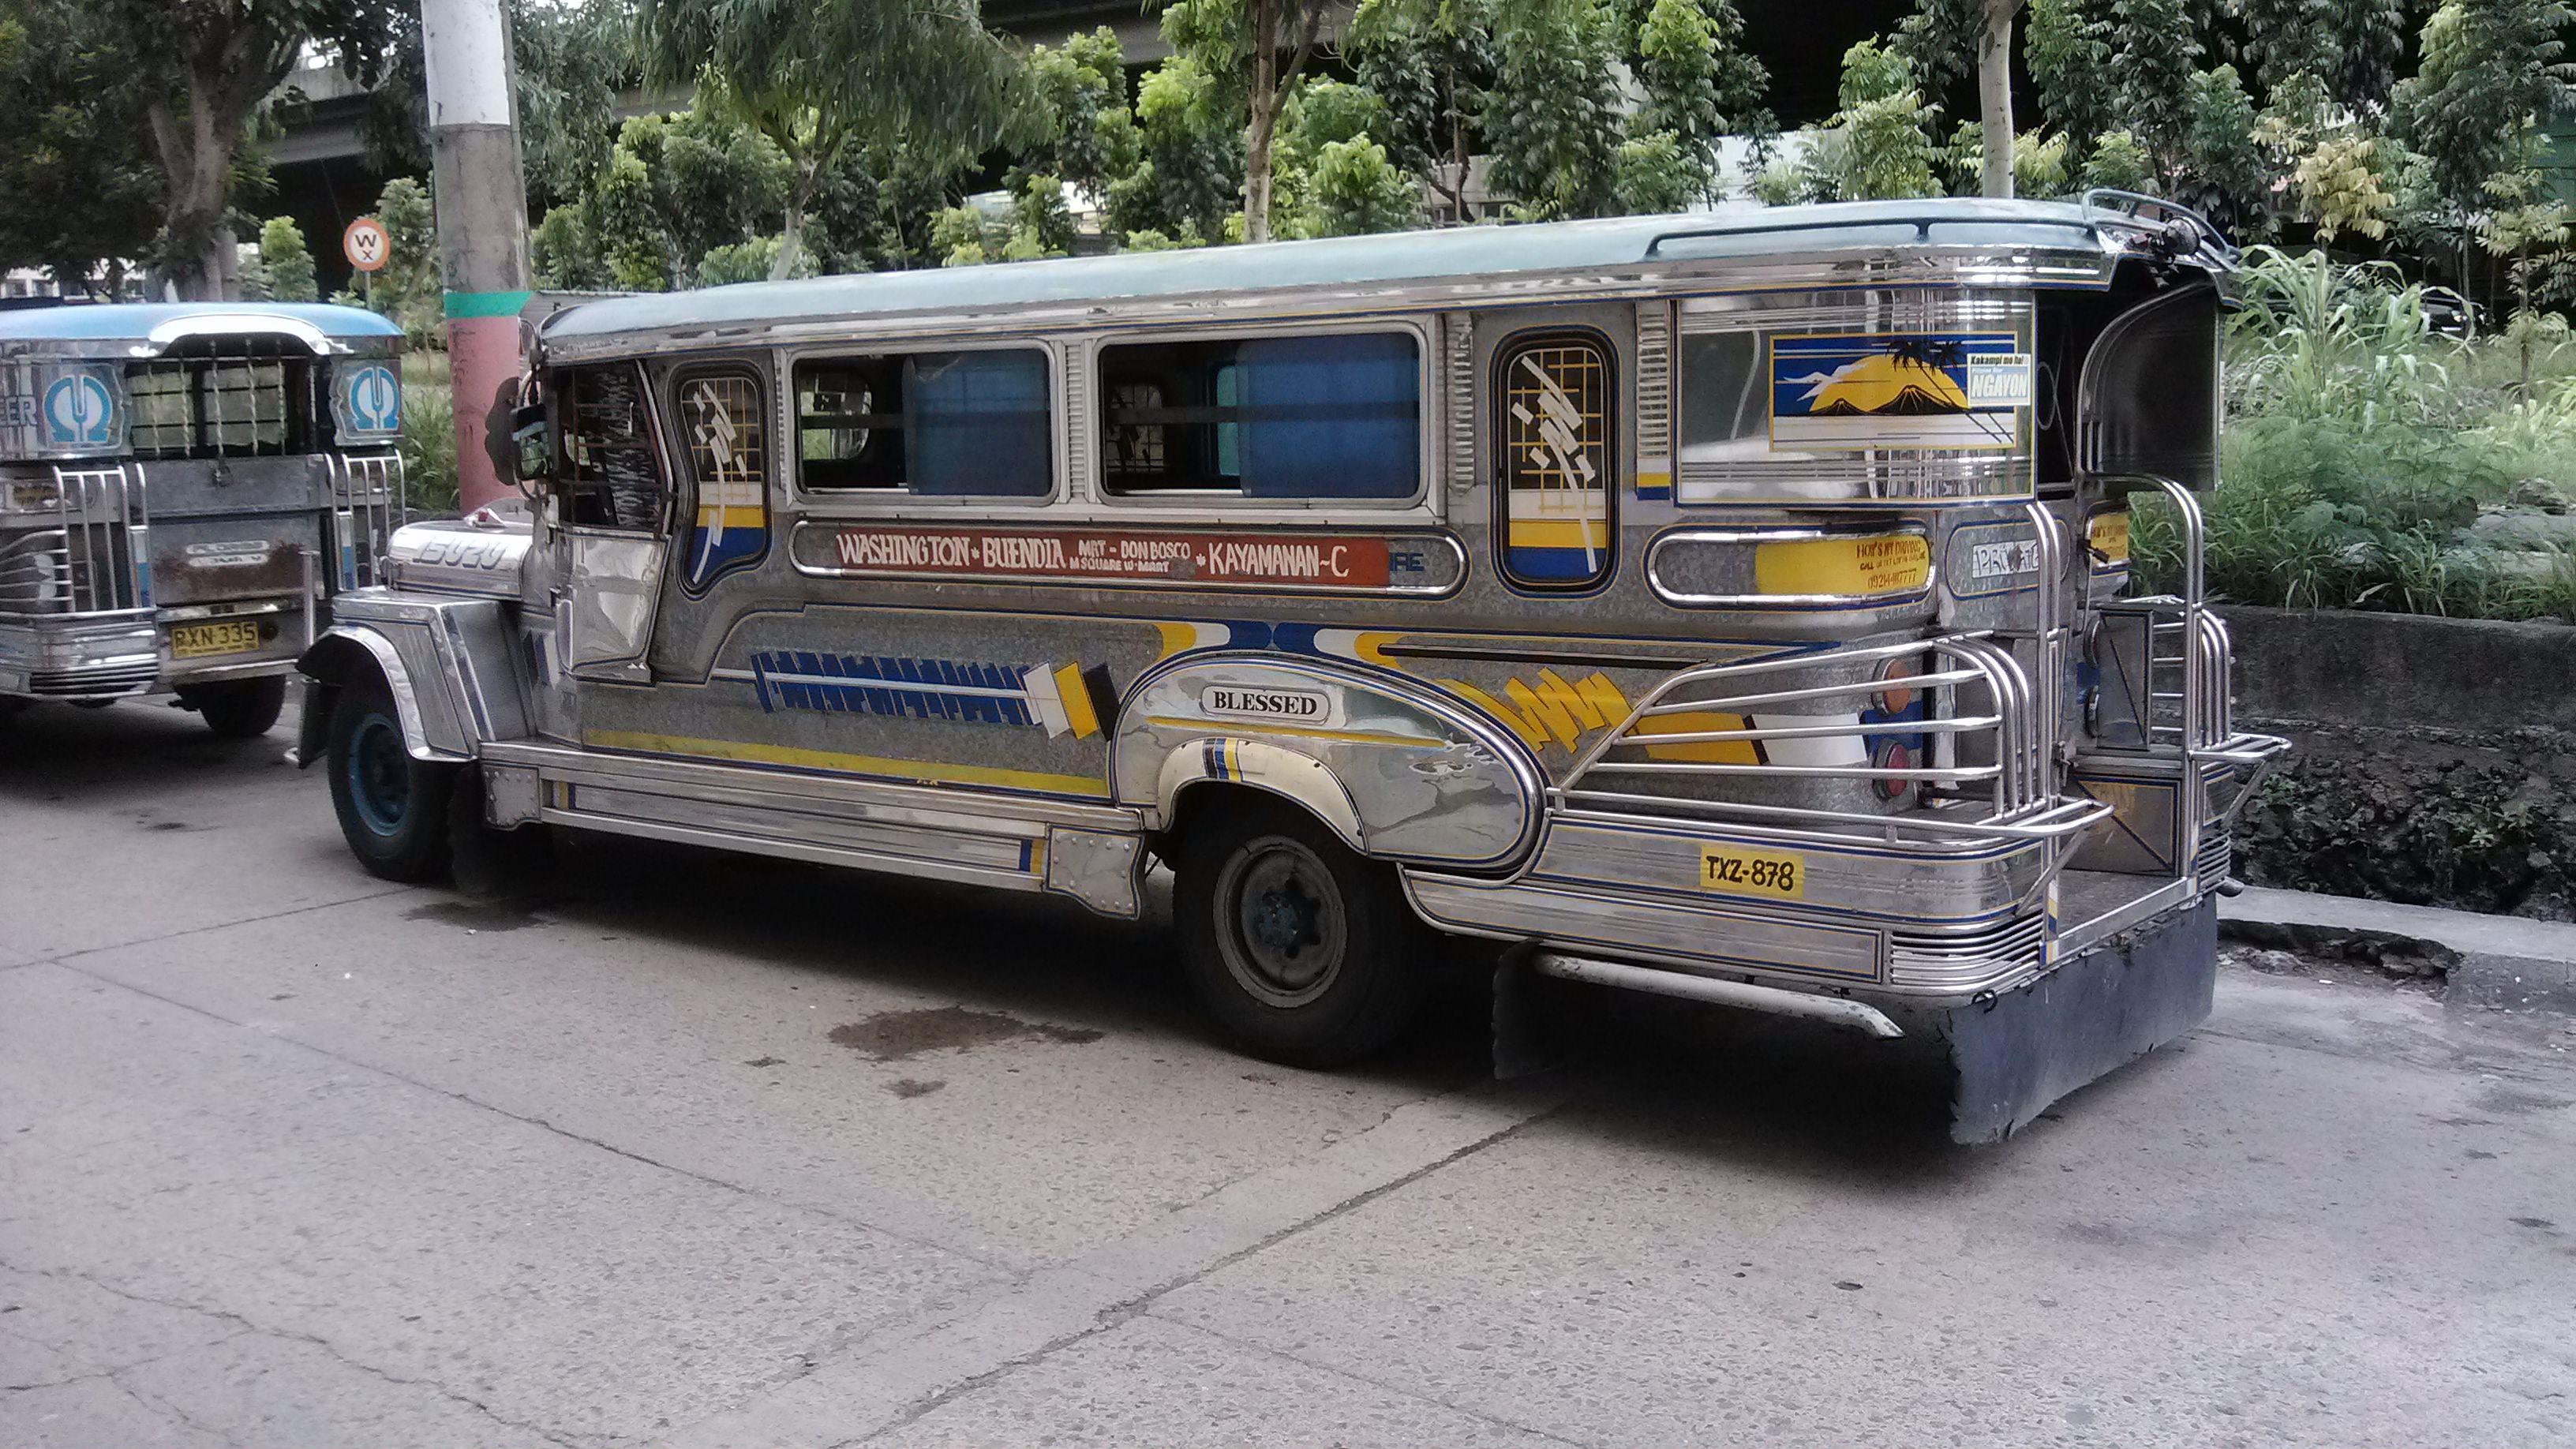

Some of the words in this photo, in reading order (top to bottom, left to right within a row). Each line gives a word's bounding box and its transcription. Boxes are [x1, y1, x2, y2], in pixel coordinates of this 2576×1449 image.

[355, 234, 376, 247] W
[1971, 374, 2027, 397] NGAYON
[412, 537, 508, 570] ISUZU
[837, 534, 970, 567] WASHINGTON
[983, 537, 1066, 569] BUENDIA
[1078, 540, 1106, 558] MRT
[1149, 541, 1191, 560] BOSCO
[174, 627, 213, 649] RXN
[218, 620, 256, 645] 335
[1212, 691, 1317, 715] BLESSED
[1705, 855, 1795, 892] TXZ-878
